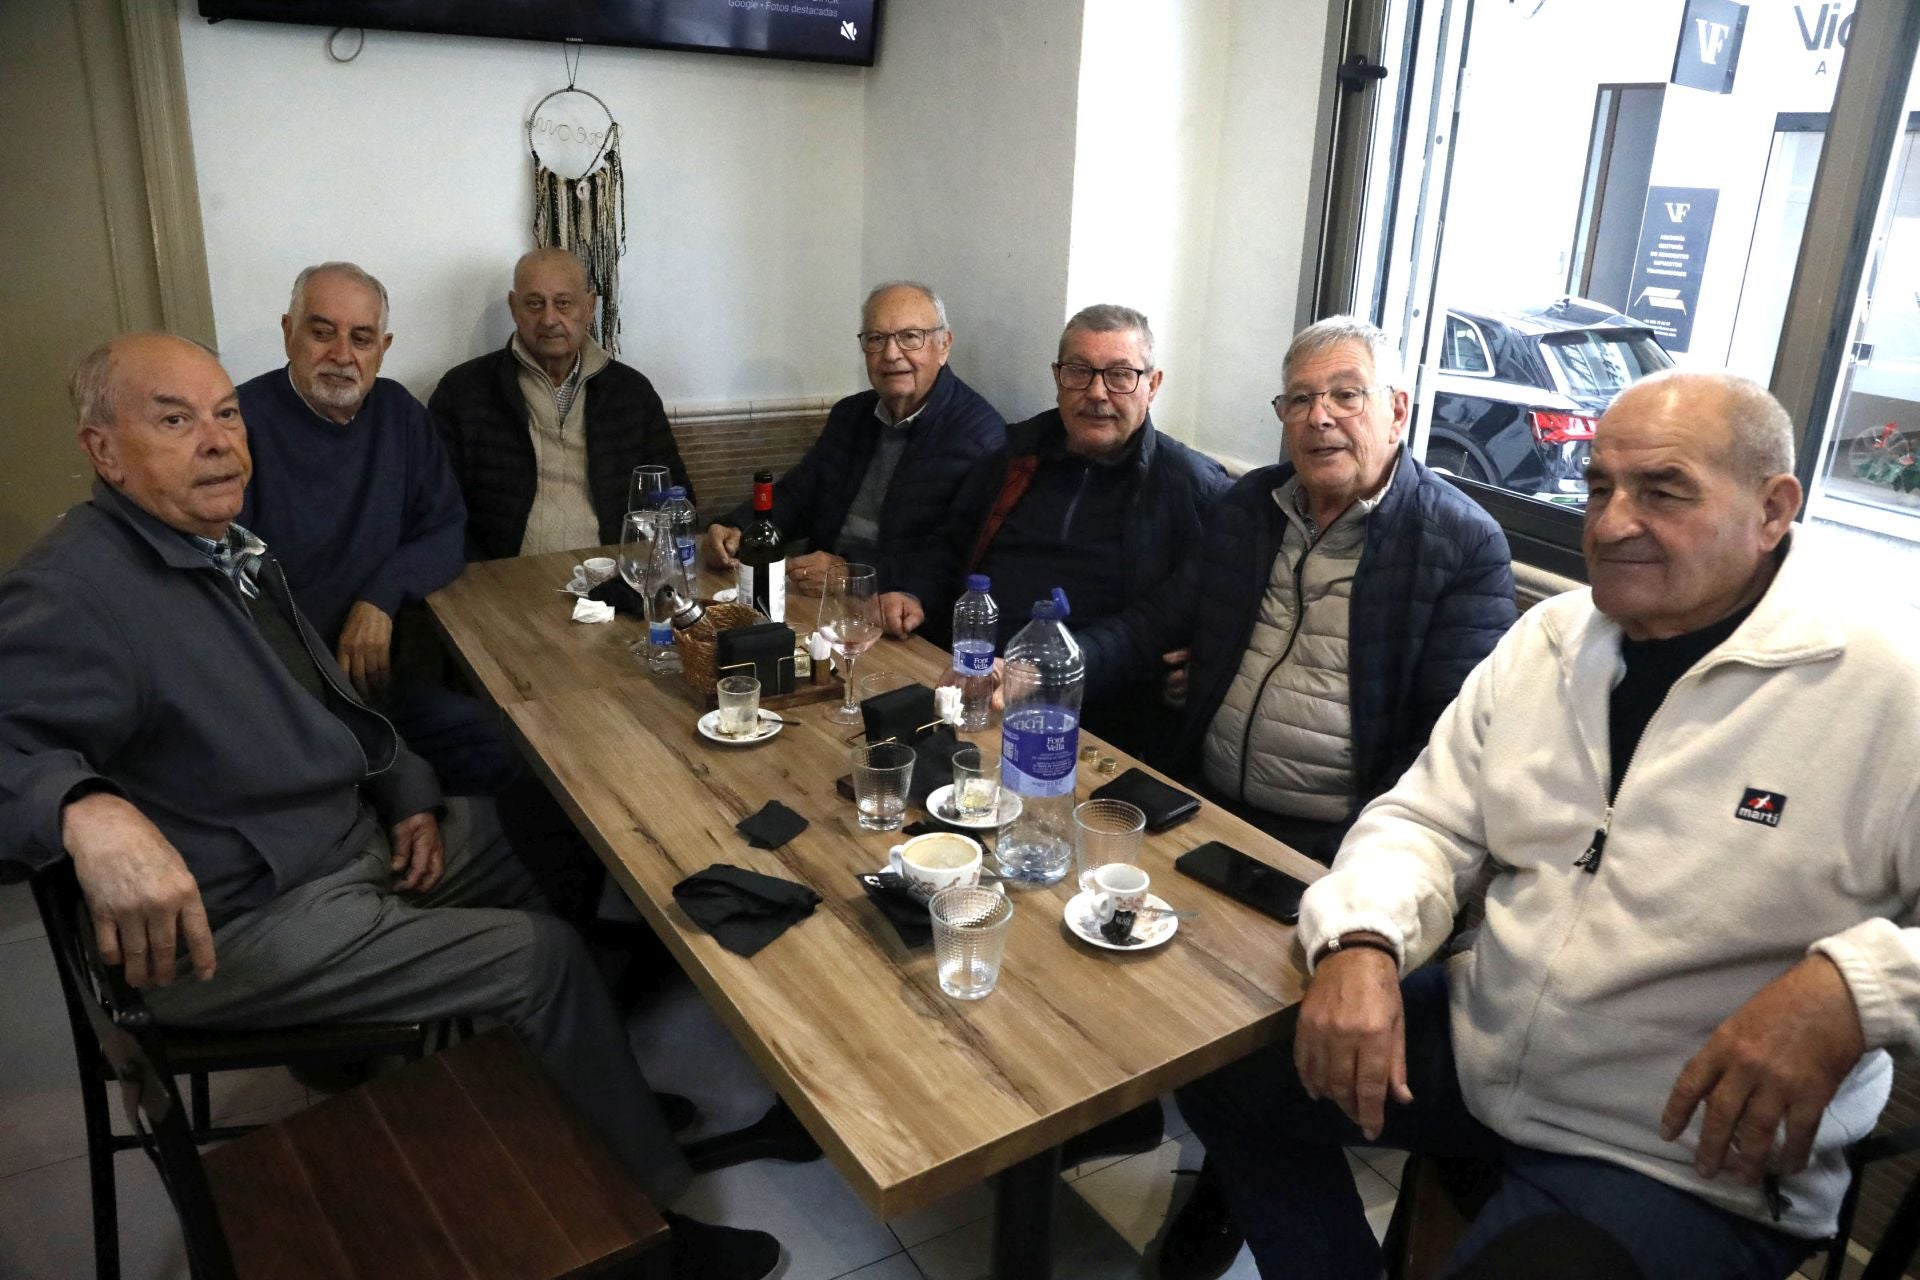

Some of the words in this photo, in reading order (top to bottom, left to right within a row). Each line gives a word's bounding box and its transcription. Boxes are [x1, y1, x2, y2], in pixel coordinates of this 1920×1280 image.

[728, 0, 759, 10] Google
[765, 1, 789, 12] Fotos
[791, 5, 838, 17] destacadas
[1695, 18, 1729, 65] VF
[1664, 202, 1690, 223] VF
[973, 662, 988, 670] Vella
[1046, 742, 1065, 752] Vella
[1047, 736, 1065, 745] Font
